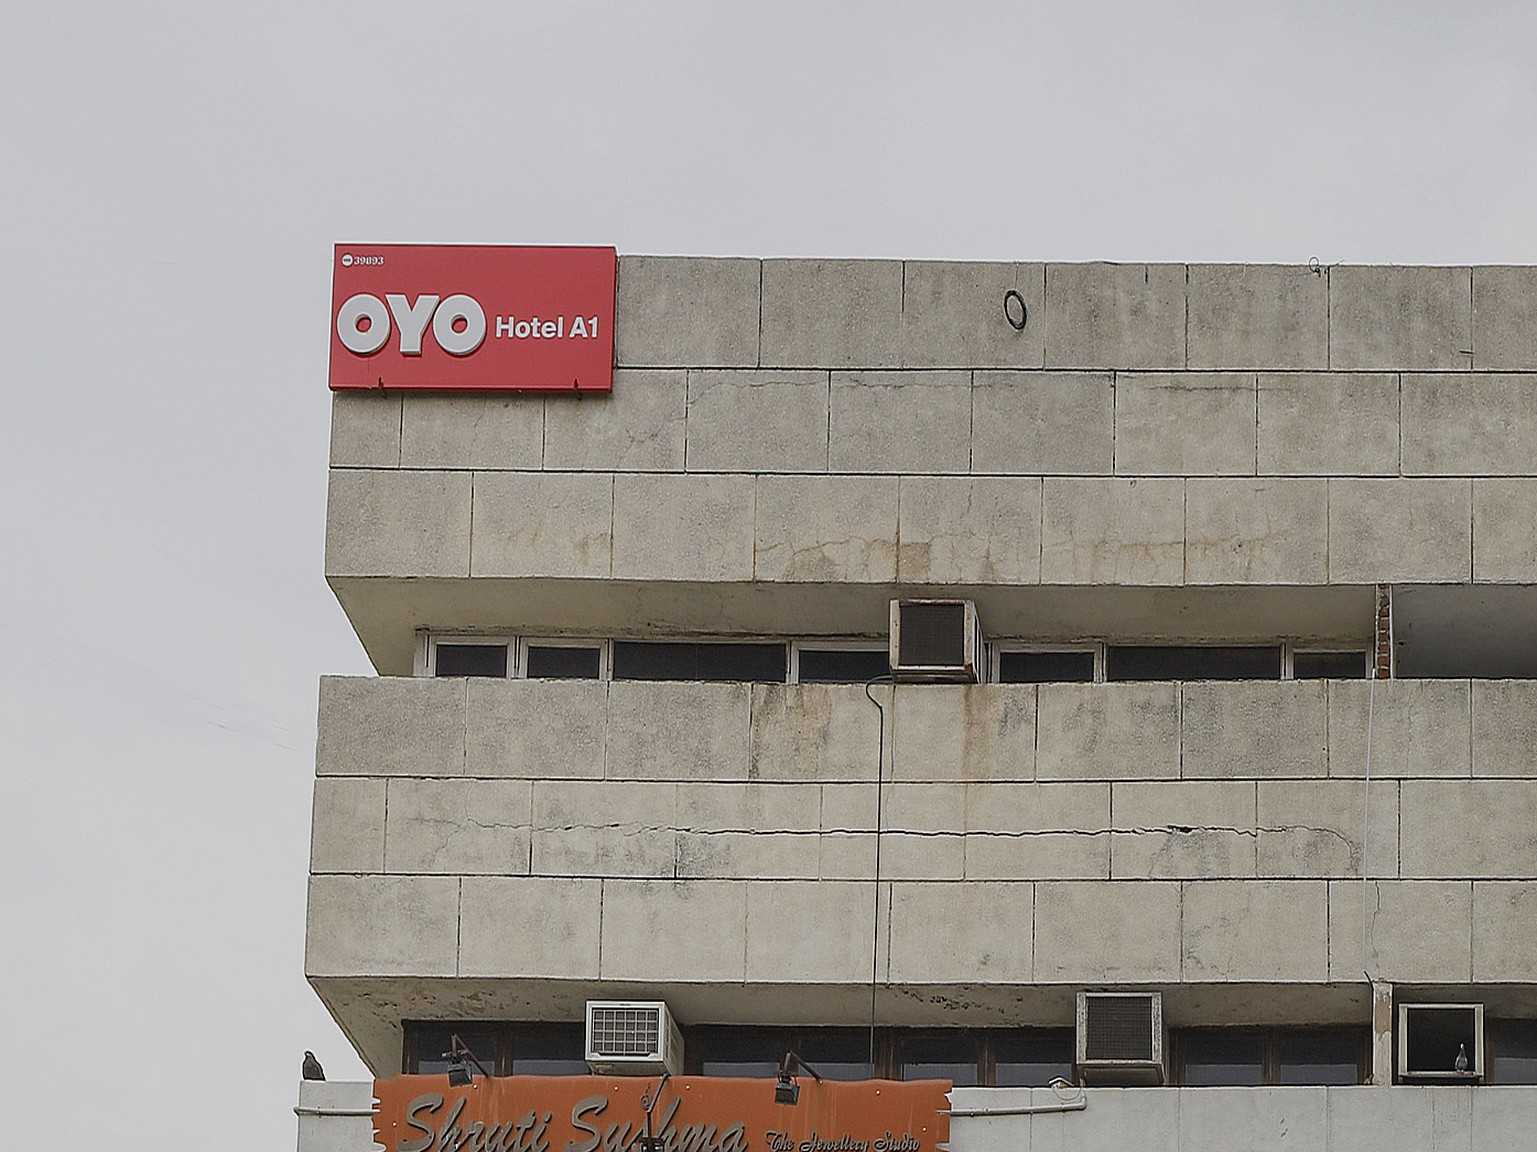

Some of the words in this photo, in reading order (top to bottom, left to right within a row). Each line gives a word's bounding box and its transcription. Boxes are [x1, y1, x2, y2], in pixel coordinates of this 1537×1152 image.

[336, 293, 488, 356] OYO
[495, 315, 564, 339] Hotel
[568, 315, 599, 339] A1
